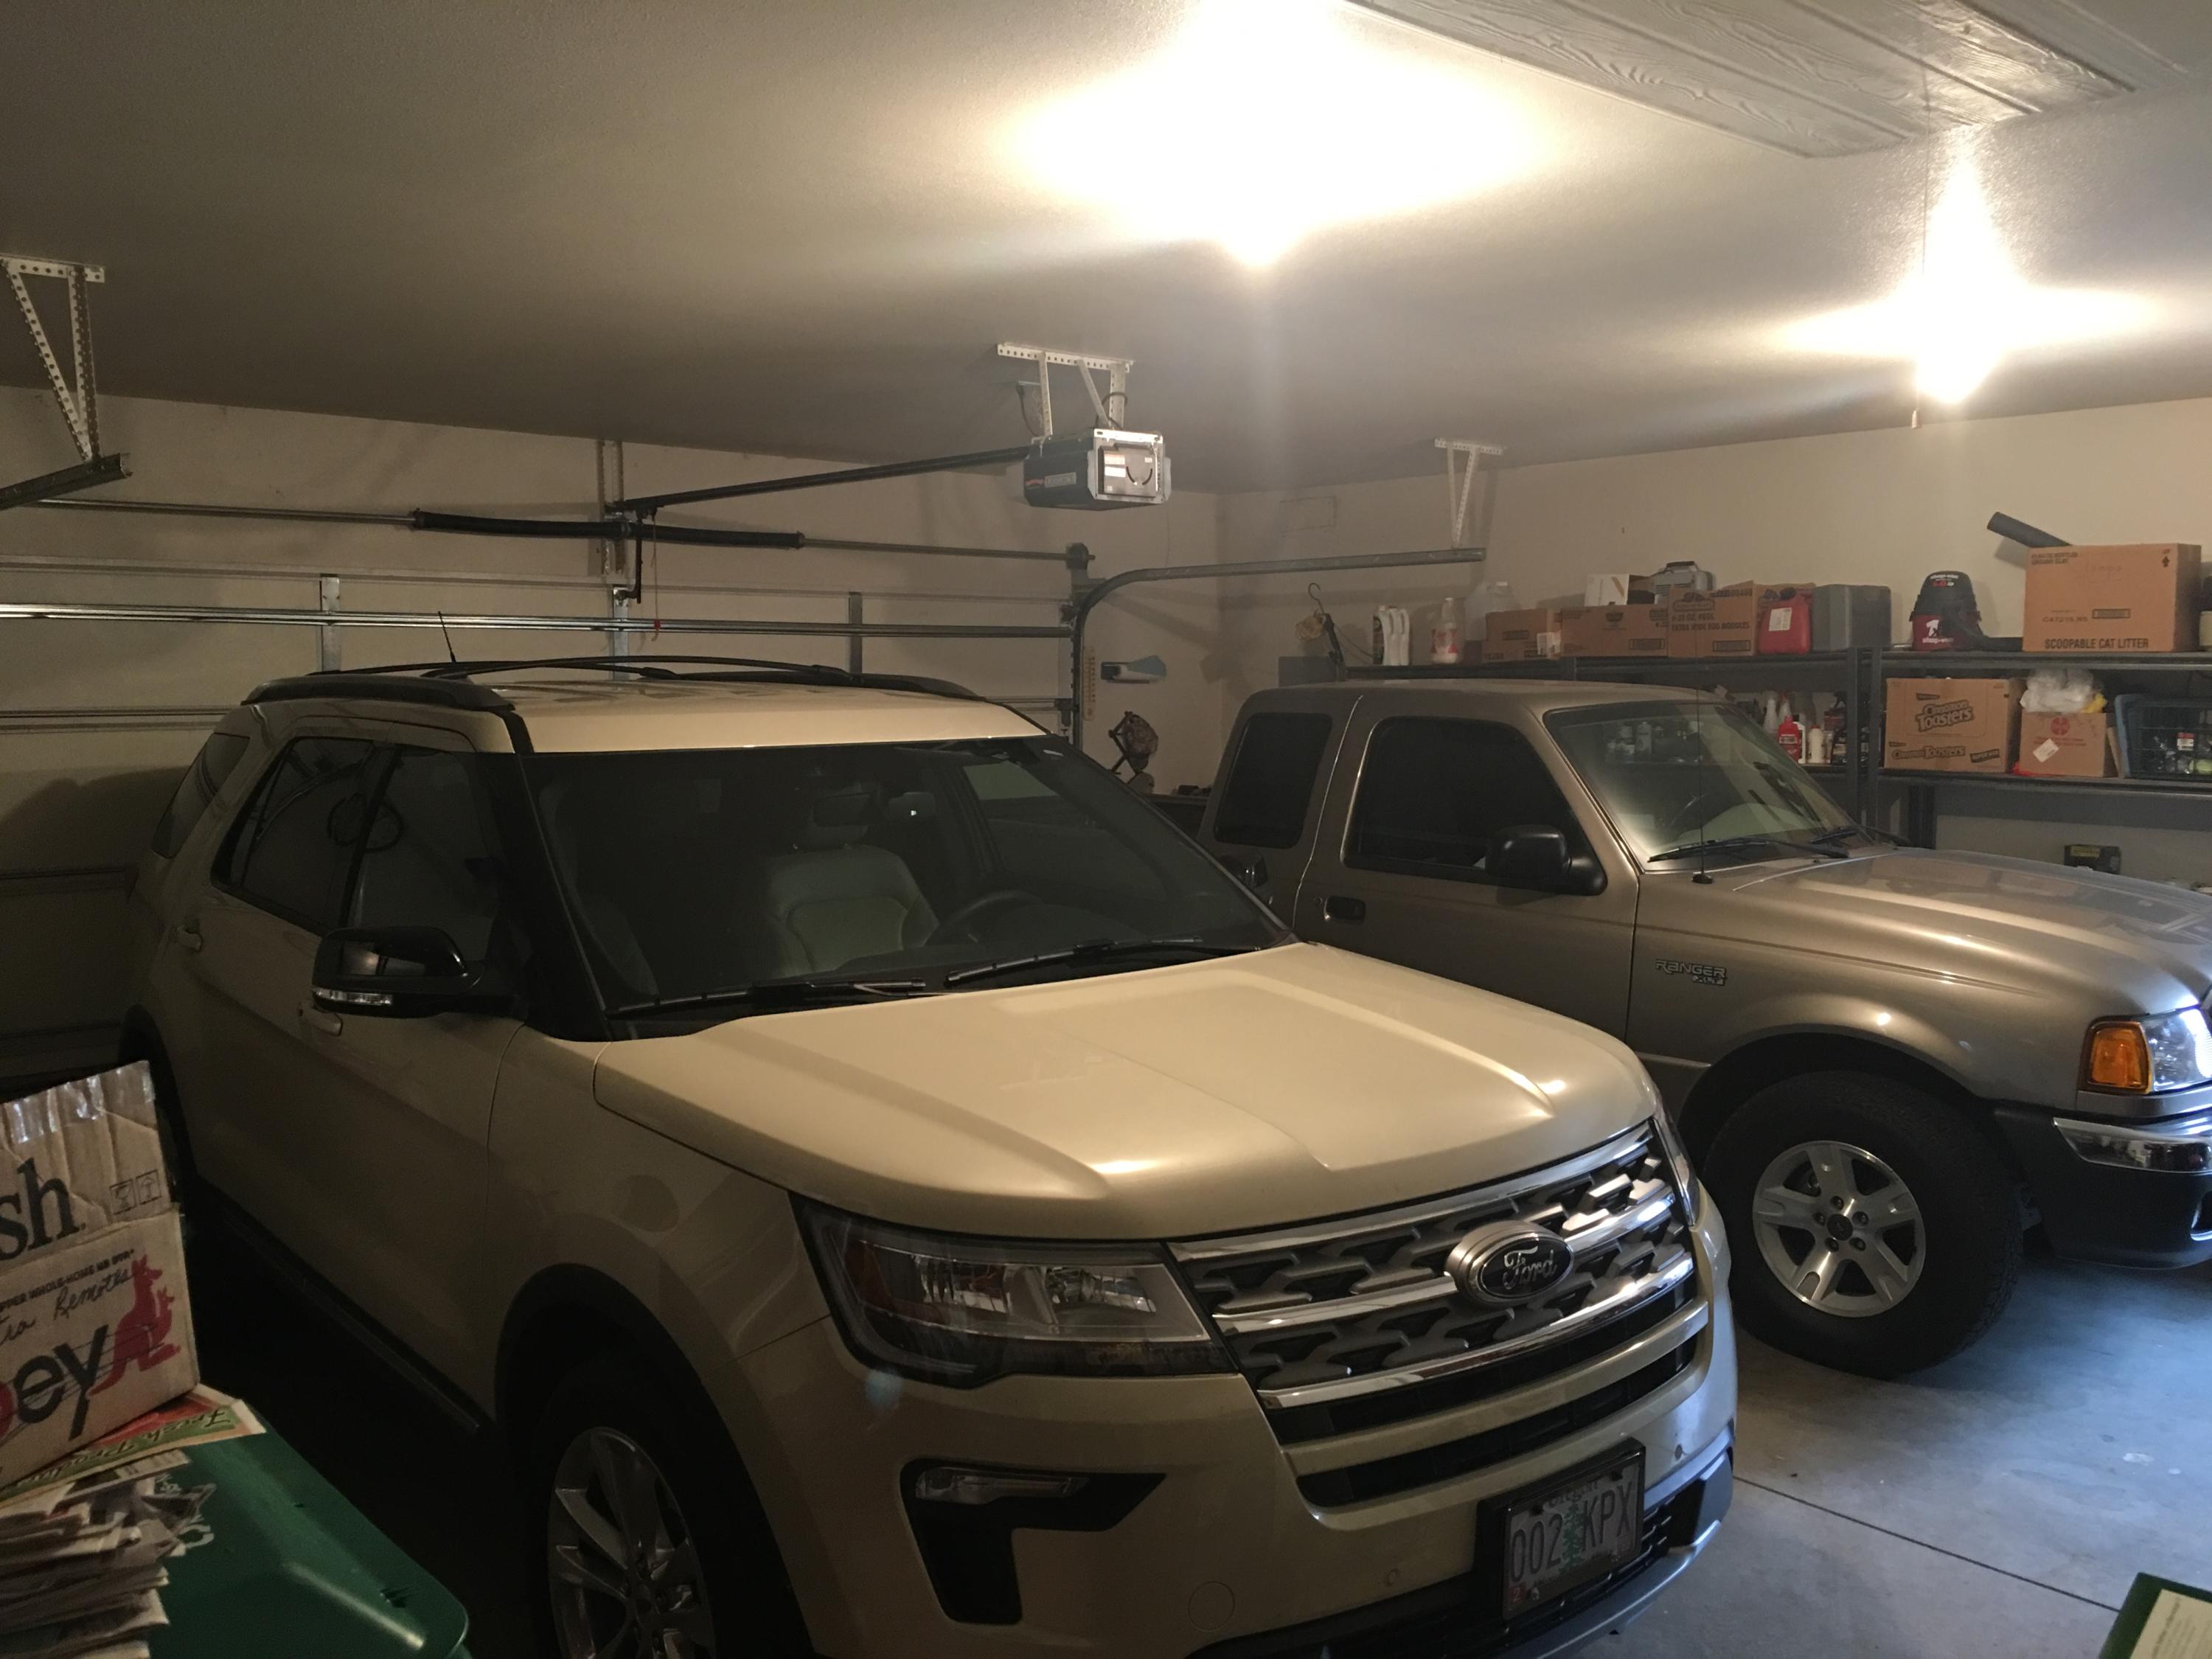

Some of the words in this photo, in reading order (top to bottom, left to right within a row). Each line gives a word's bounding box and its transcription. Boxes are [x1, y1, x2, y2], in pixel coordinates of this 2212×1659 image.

[2045, 639, 2096, 649] SCOOPABLE
[2098, 639, 2115, 649] CAT
[2118, 638, 2149, 648] LITTER
[1917, 707, 1974, 731] Toasters
[1924, 746, 1966, 759] Toasters
[1502, 1246, 1557, 1290] Ford
[0, 1325, 108, 1441] ey
[1510, 1513, 1563, 1583] 002
[1582, 1481, 1632, 1552] KPX
